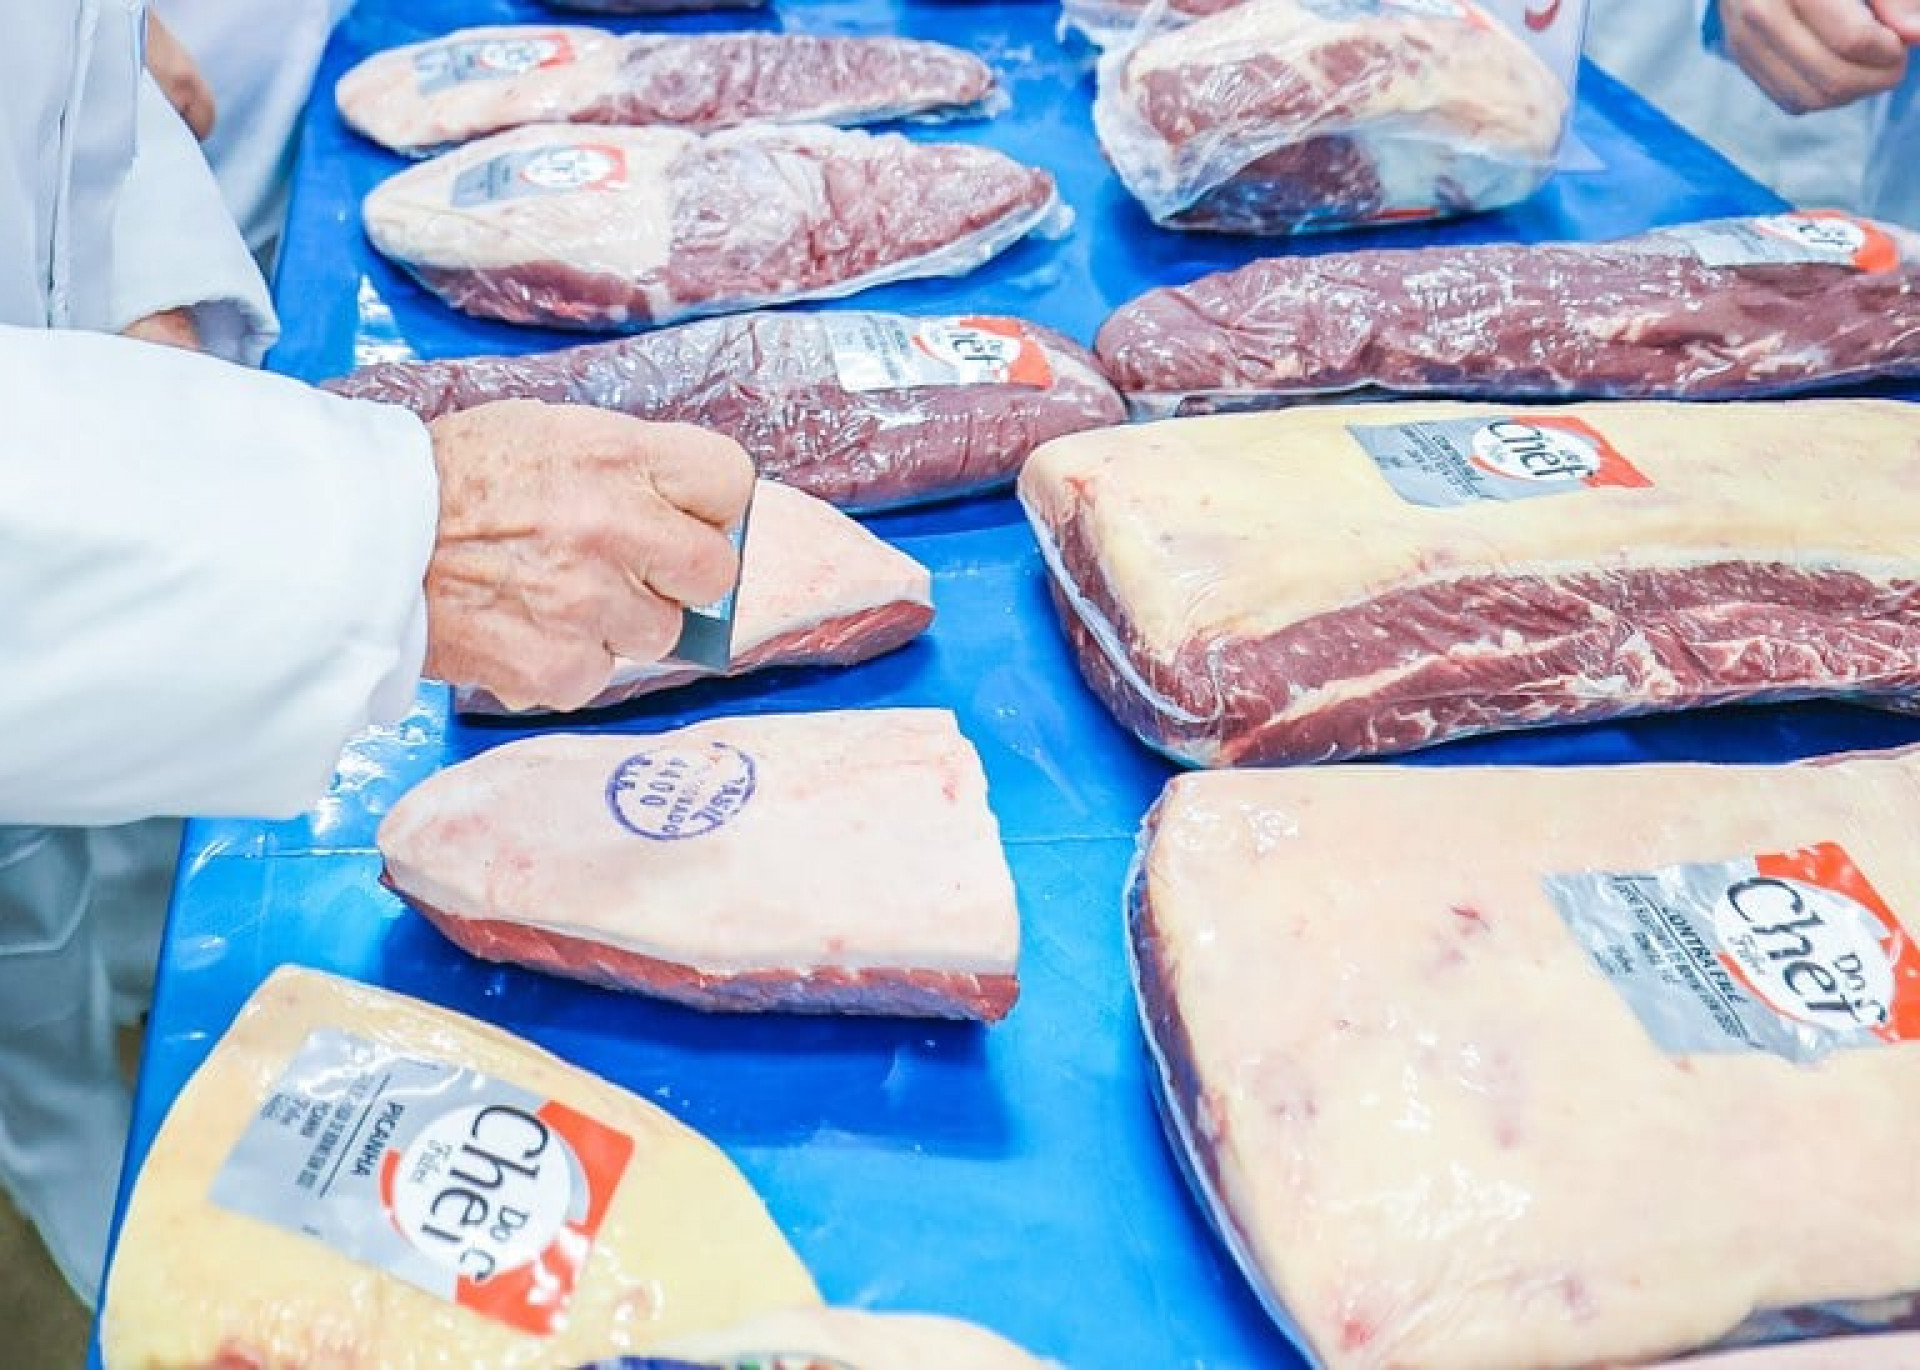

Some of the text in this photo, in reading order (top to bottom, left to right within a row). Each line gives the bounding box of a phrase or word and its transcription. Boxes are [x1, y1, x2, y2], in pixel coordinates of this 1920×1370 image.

[1726, 877, 1887, 1023] Chef
[350, 1101, 406, 1176] PICANHA
[490, 1205, 530, 1241] Do
